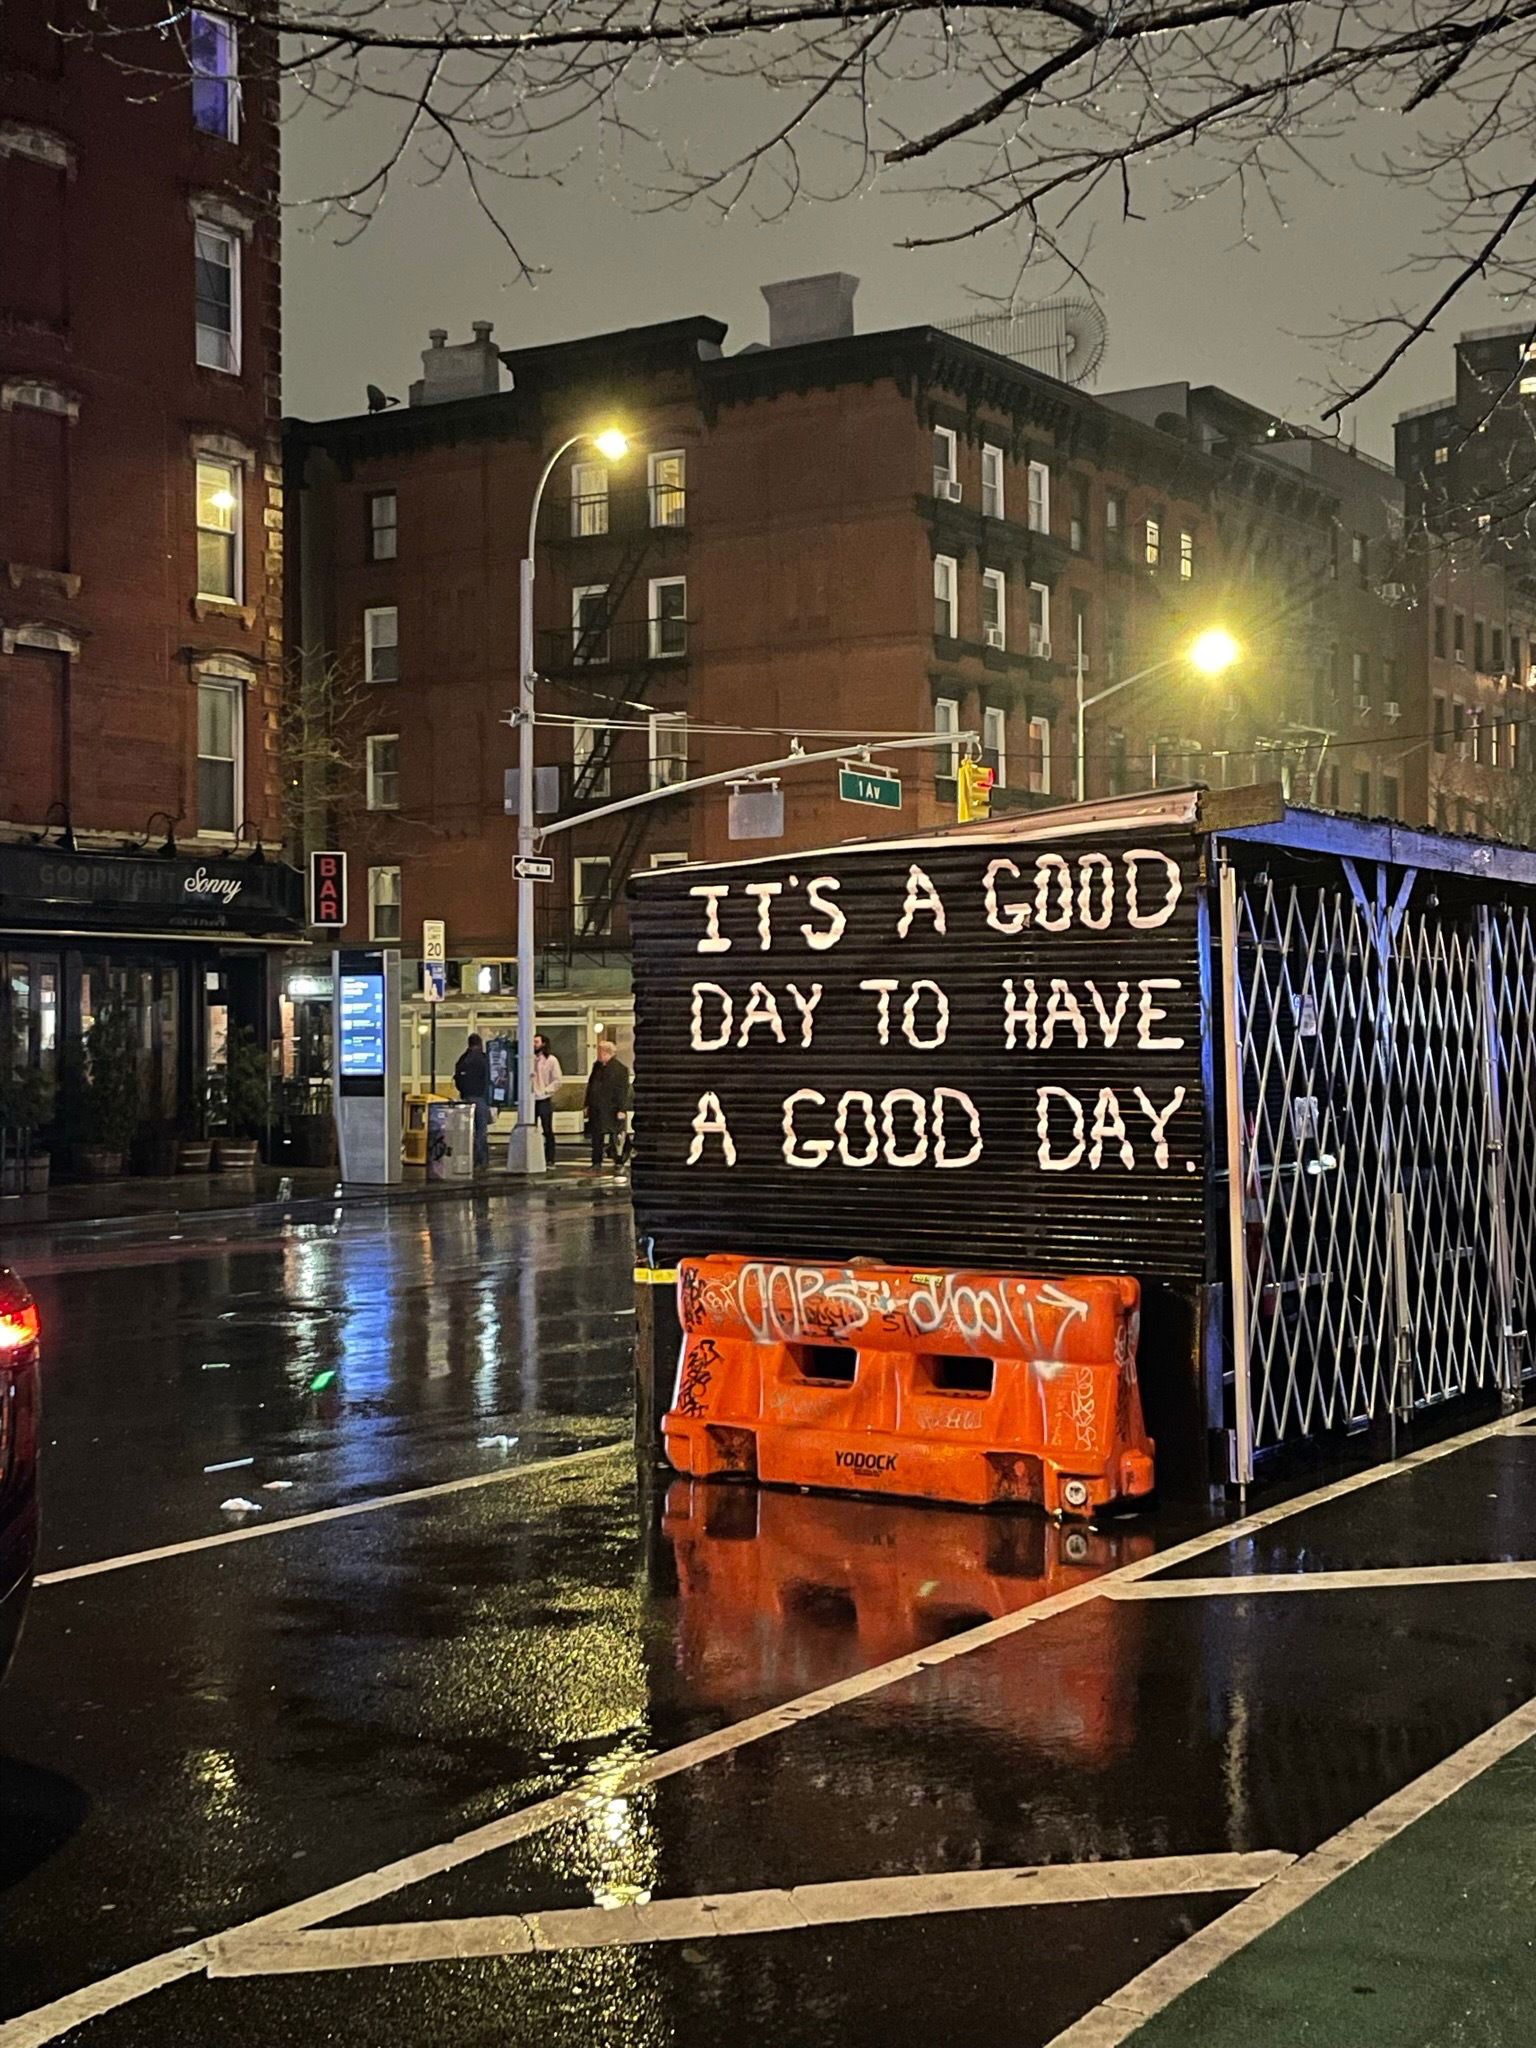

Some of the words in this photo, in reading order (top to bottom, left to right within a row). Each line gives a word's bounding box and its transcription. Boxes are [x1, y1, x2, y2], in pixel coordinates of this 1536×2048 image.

[859, 780, 863, 797] 1
[866, 782, 880, 800] Av
[40, 864, 176, 890] GOODNIGHT
[184, 867, 242, 903] Sonny
[320, 858, 338, 920] BAR
[690, 875, 847, 952] IT'S
[898, 864, 946, 939] A
[982, 852, 1183, 934] GOOD
[427, 943, 442, 956] 20
[691, 982, 823, 1051] DAY
[860, 979, 950, 1049] TO
[1002, 978, 1185, 1050] HAVE
[687, 1091, 737, 1167] A
[782, 1087, 984, 1169] GOOD
[1036, 1086, 1196, 1172] DAY.
[834, 1450, 897, 1472] YODOCK
